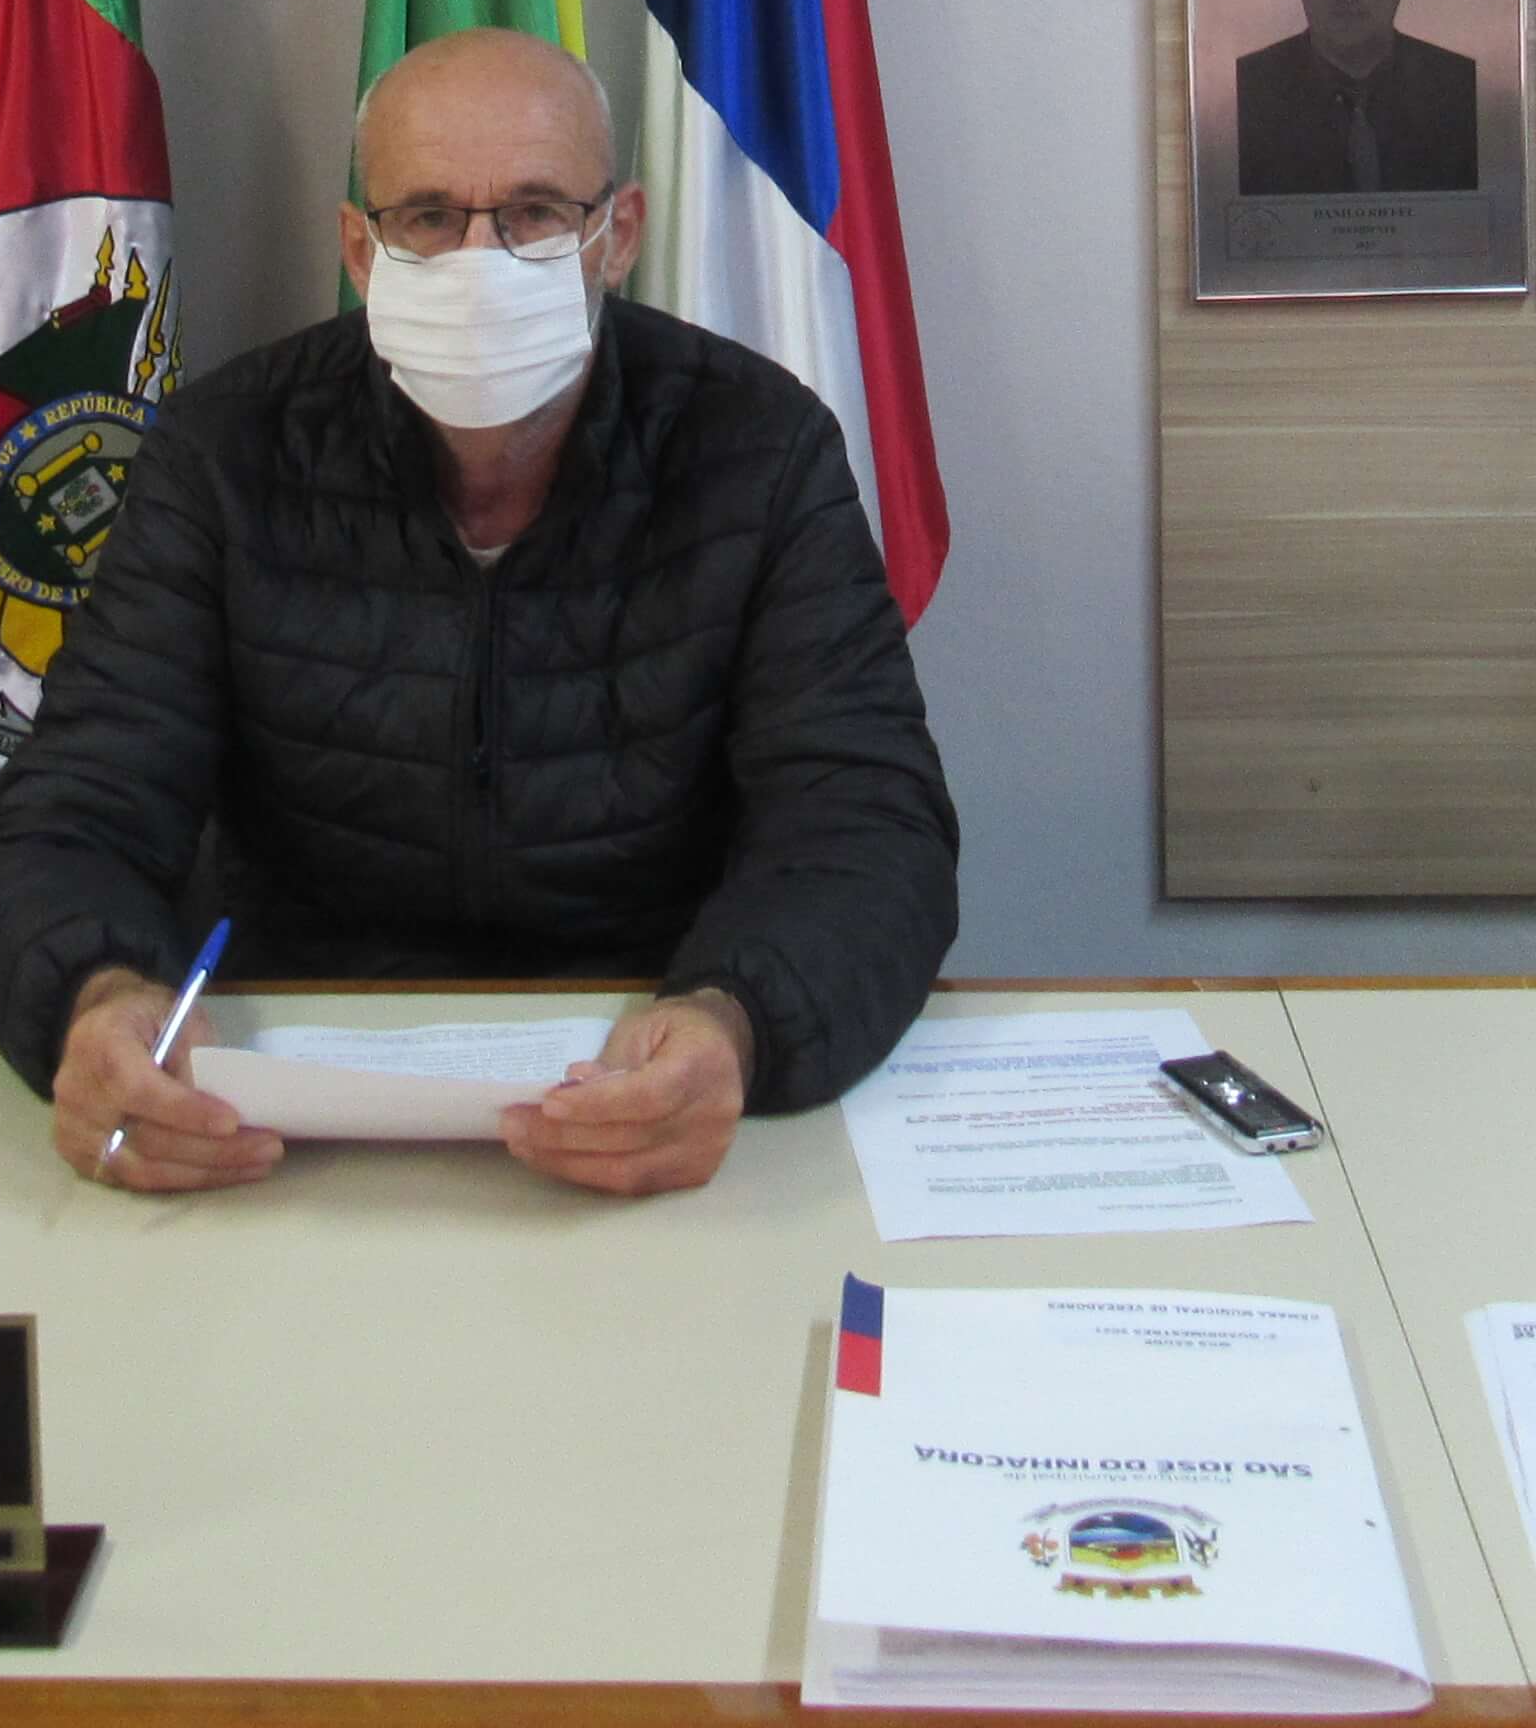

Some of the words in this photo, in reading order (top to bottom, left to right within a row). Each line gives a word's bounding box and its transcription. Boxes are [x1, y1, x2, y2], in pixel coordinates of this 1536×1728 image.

[43, 391, 145, 426] REPÚBLICA
[35, 582, 63, 602] DE
[1148, 1304, 1169, 1312] DE
[1174, 1306, 1254, 1318] MUNICIPAL
[914, 1444, 1090, 1470] INHACORÁ
[1099, 1459, 1146, 1471] DO
[1162, 1458, 1233, 1473] JOSÉ
[1244, 1462, 1313, 1478] SÃO
